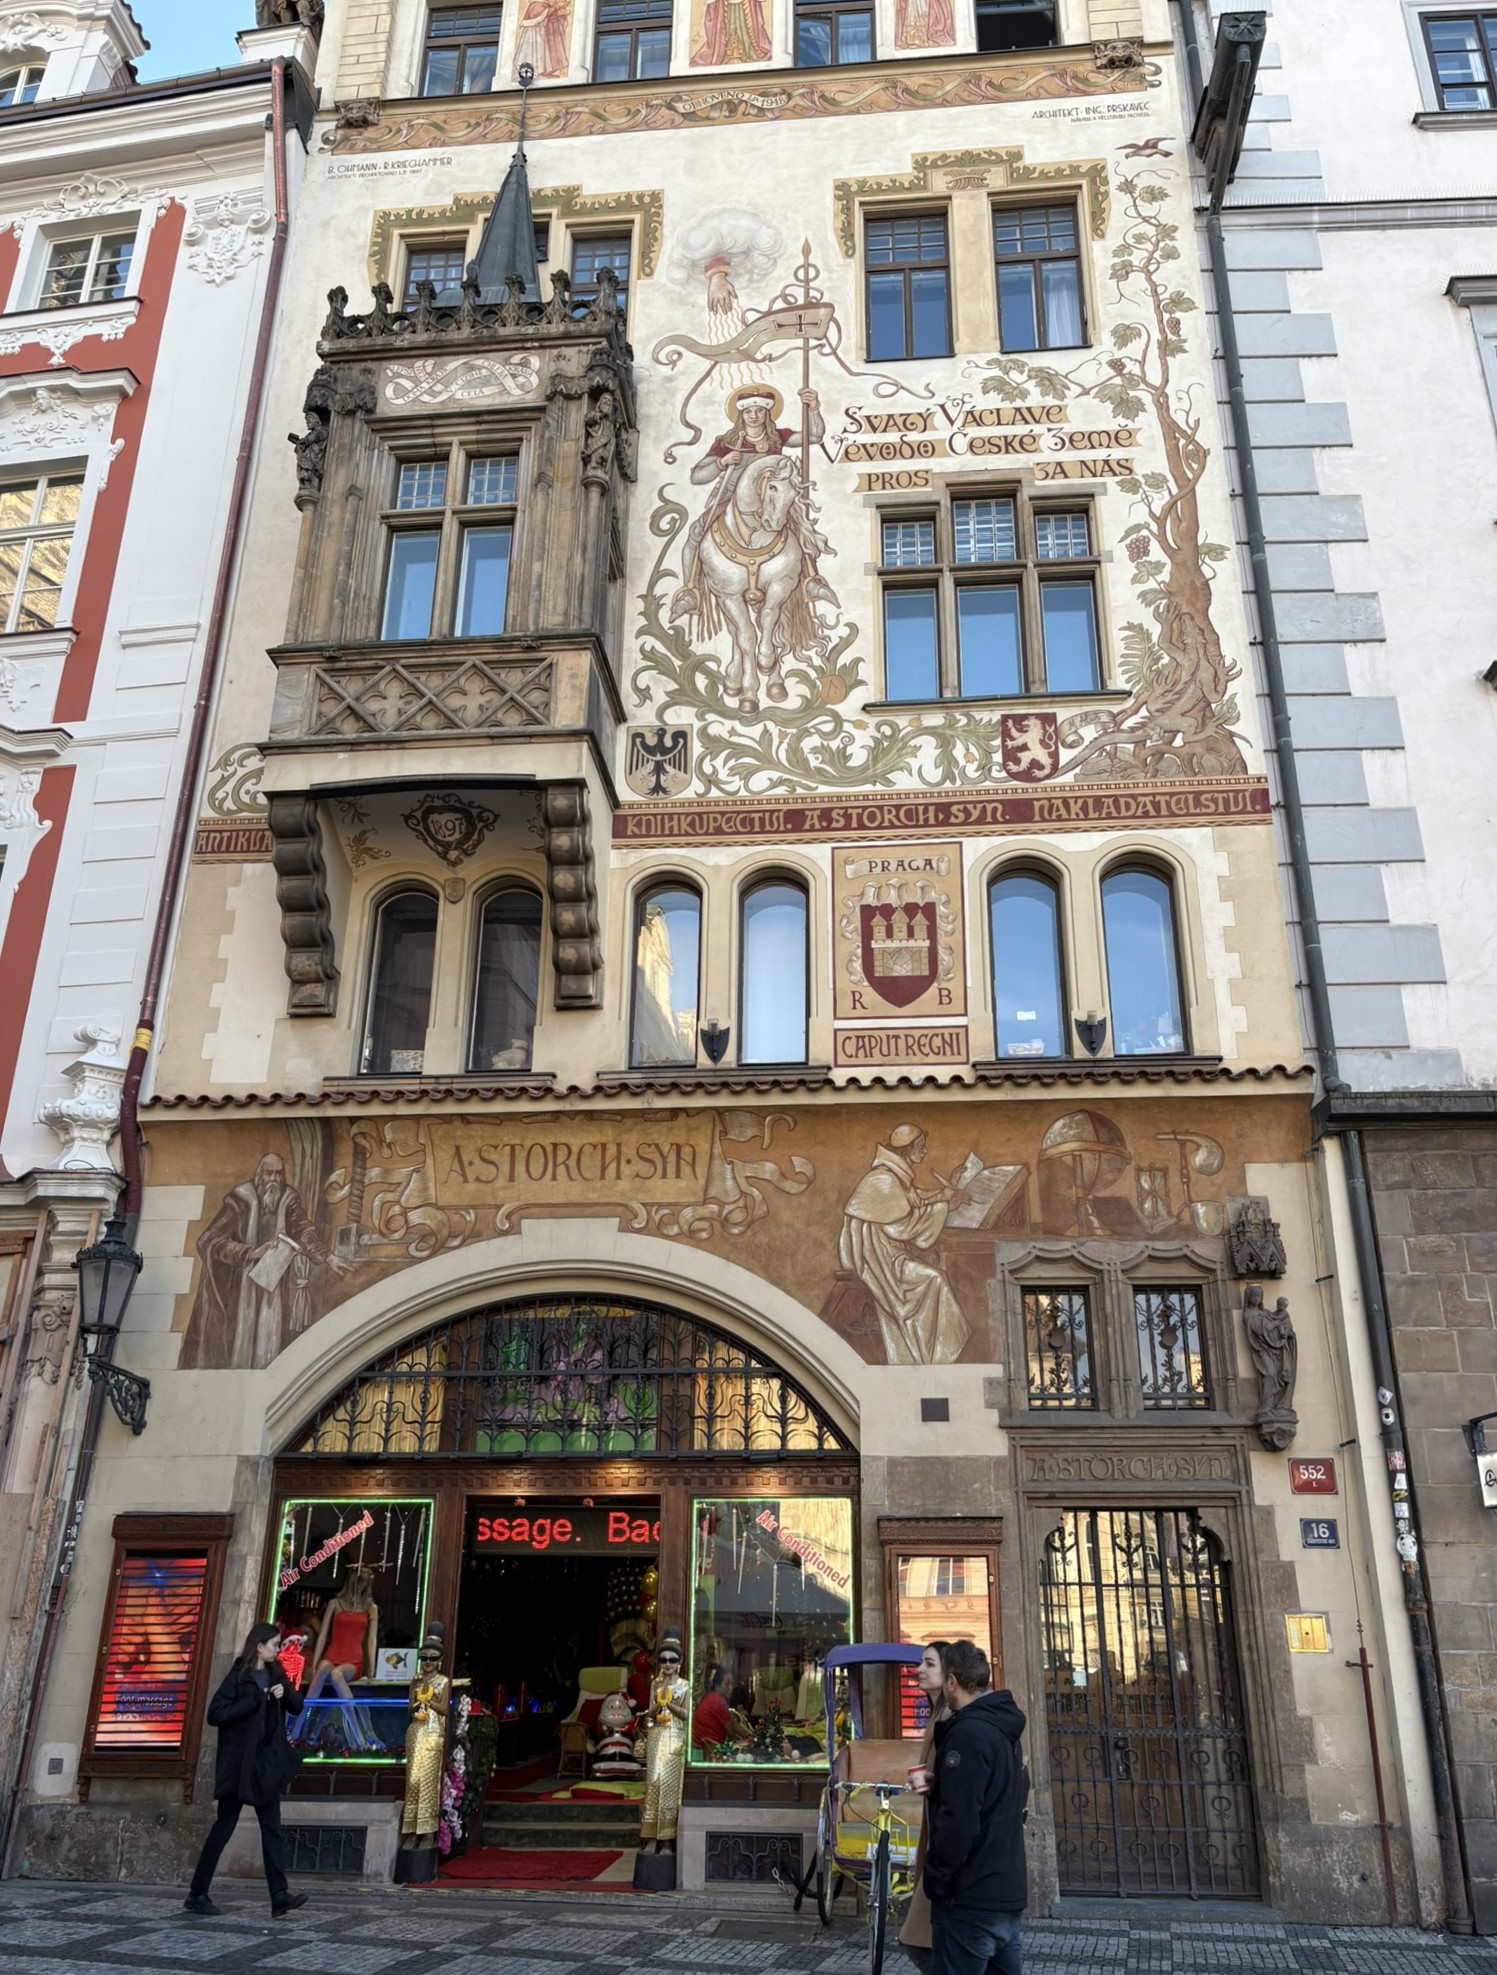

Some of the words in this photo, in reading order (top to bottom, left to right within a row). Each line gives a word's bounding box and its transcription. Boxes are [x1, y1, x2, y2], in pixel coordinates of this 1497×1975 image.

[683, 91, 745, 112] OBNOVENO
[1085, 105, 1105, 115] ING.
[337, 162, 378, 174] OHMANN
[937, 393, 1064, 429] VÁCLAVE
[948, 427, 1041, 456] ČESKÉ
[866, 470, 930, 490] PROS
[1080, 453, 1134, 479] NÁS
[430, 816, 465, 838] 1897
[868, 858, 936, 873] PRAGA
[851, 990, 868, 1010] R
[937, 987, 953, 1006] B
[842, 1033, 902, 1059] CAPUT
[904, 1031, 962, 1057] REGNI
[1299, 1464, 1327, 1480] 552
[477, 1517, 582, 1550] ssage.
[1310, 1522, 1330, 1538] 16
[280, 1566, 301, 1589] Air
[300, 1510, 375, 1573] Conditioned
[755, 1509, 778, 1533] Air
[776, 1526, 850, 1589] Conditioned
